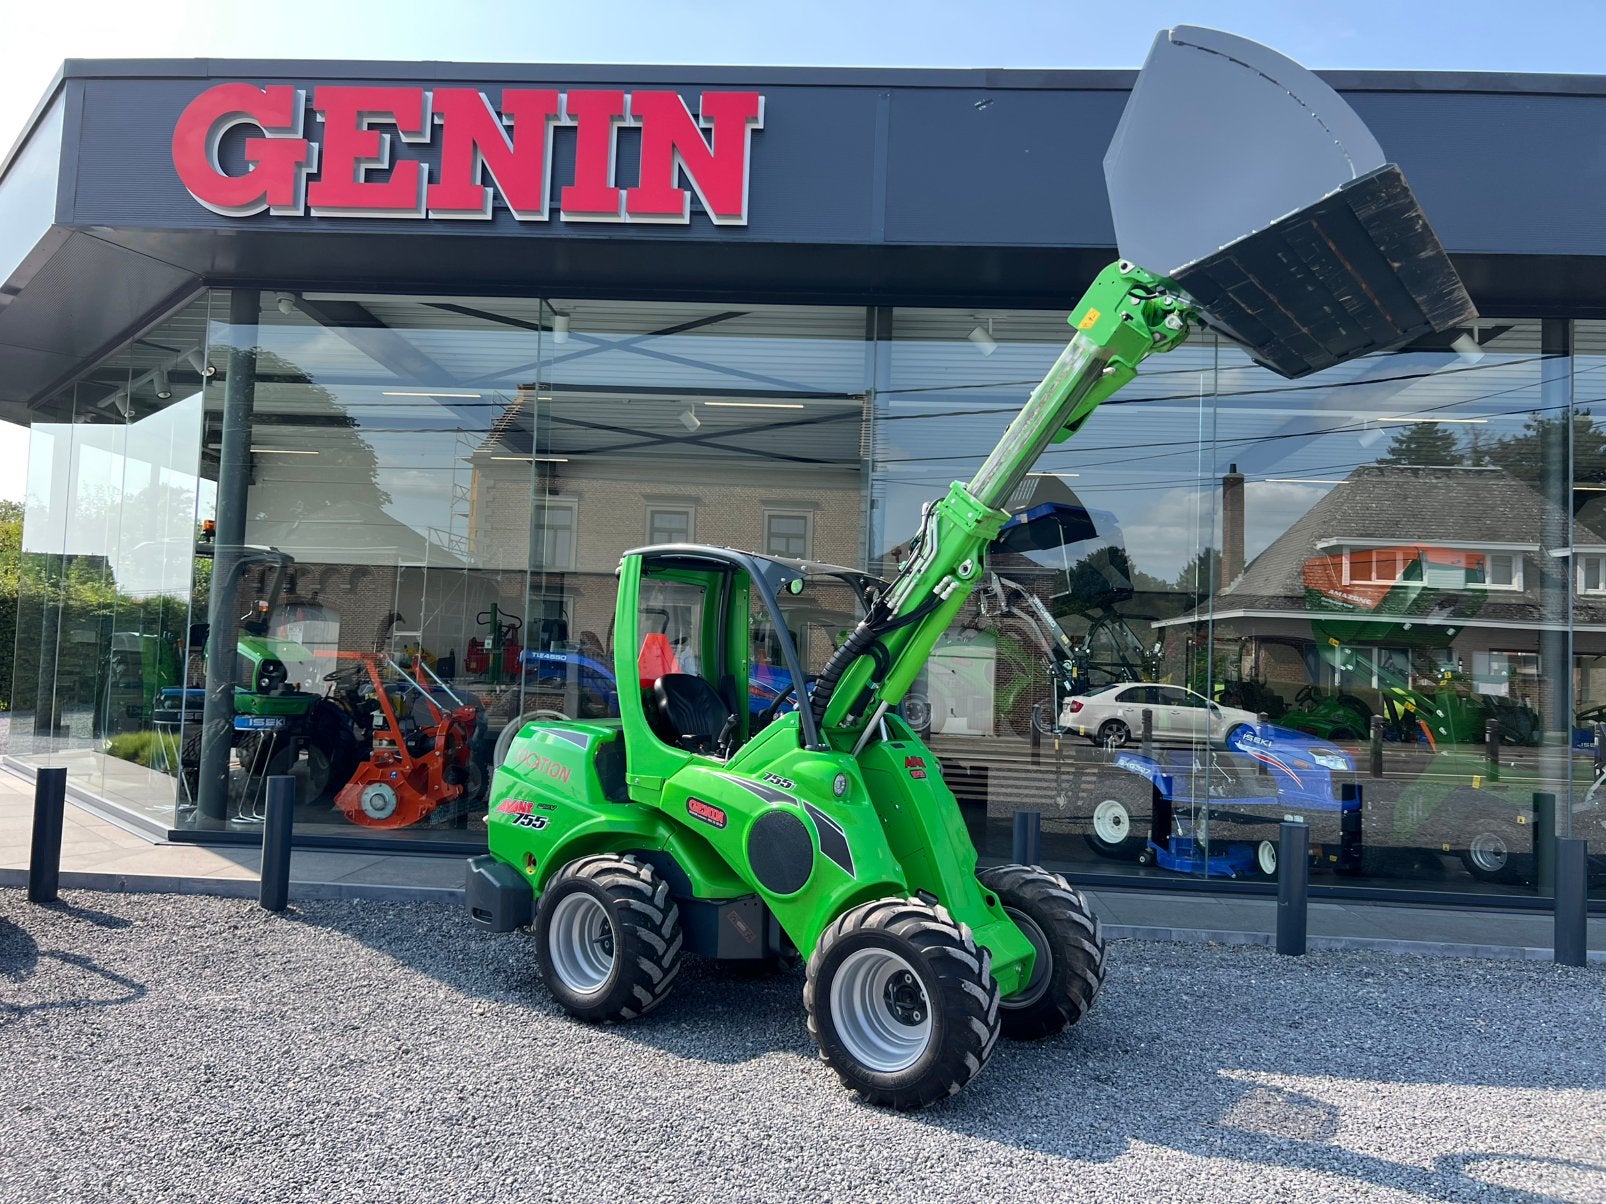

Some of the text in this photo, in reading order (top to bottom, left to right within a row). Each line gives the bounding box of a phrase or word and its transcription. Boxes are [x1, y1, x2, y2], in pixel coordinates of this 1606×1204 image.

[172, 82, 764, 226] GENIN
[514, 746, 572, 783] LOCATION
[495, 798, 535, 814] AVANT
